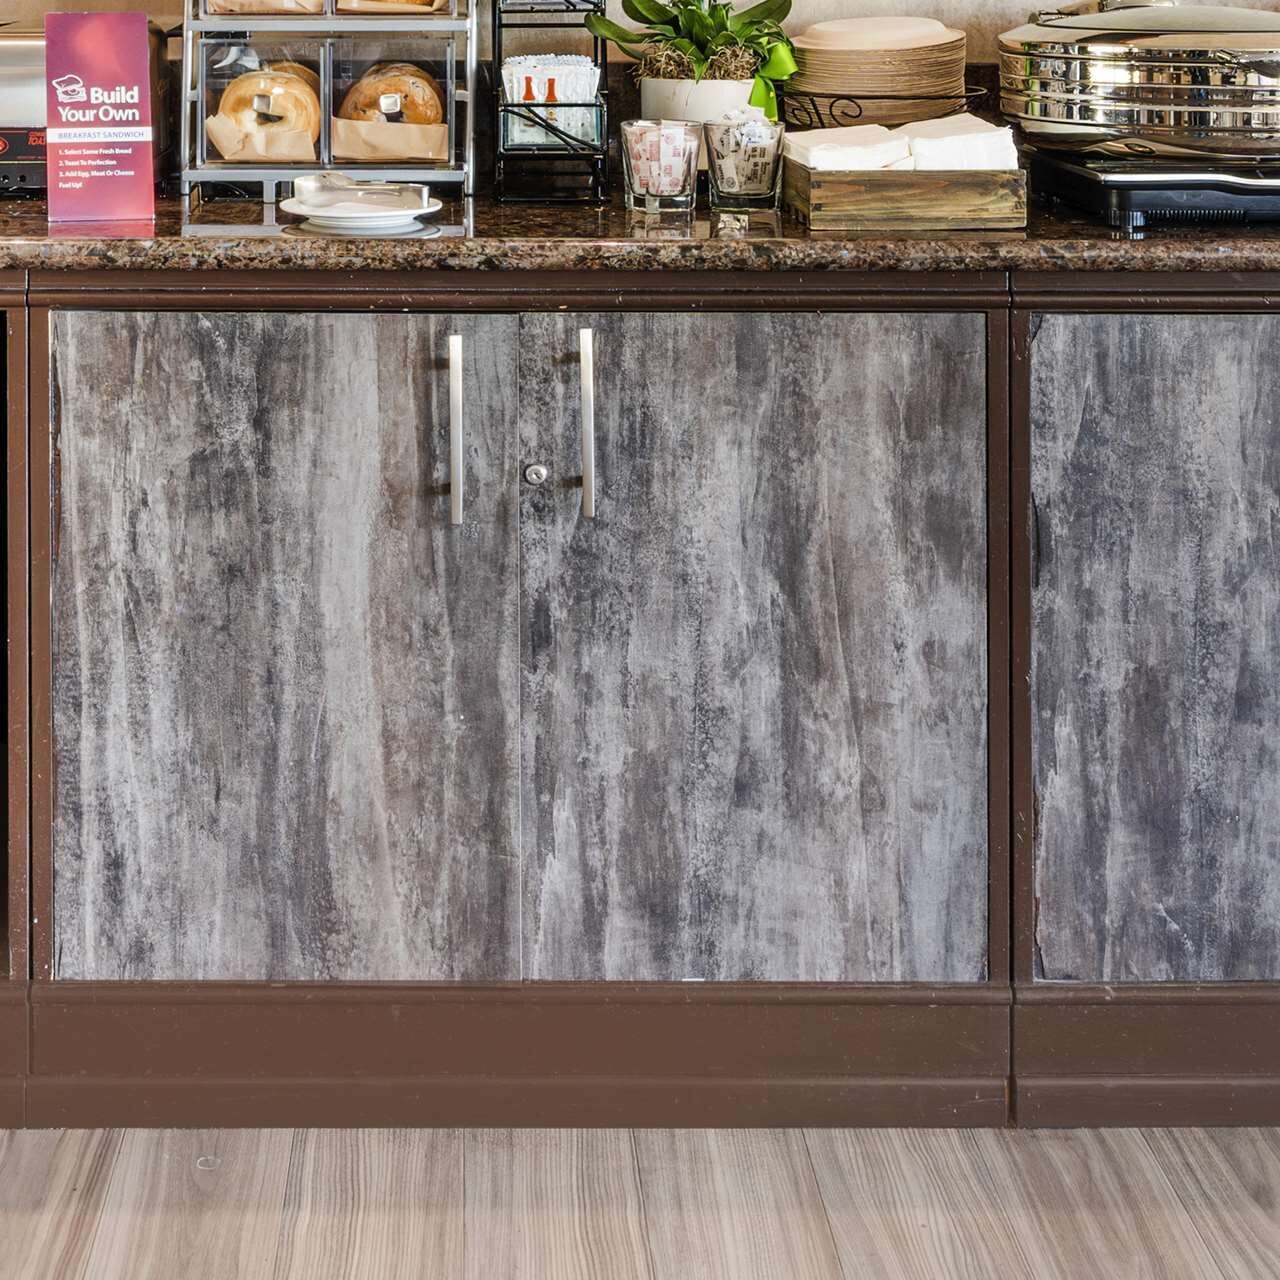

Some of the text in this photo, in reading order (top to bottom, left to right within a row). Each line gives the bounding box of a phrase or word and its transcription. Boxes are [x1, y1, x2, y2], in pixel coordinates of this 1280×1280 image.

[90, 86, 139, 103] Build
[58, 105, 139, 121] Your Own
